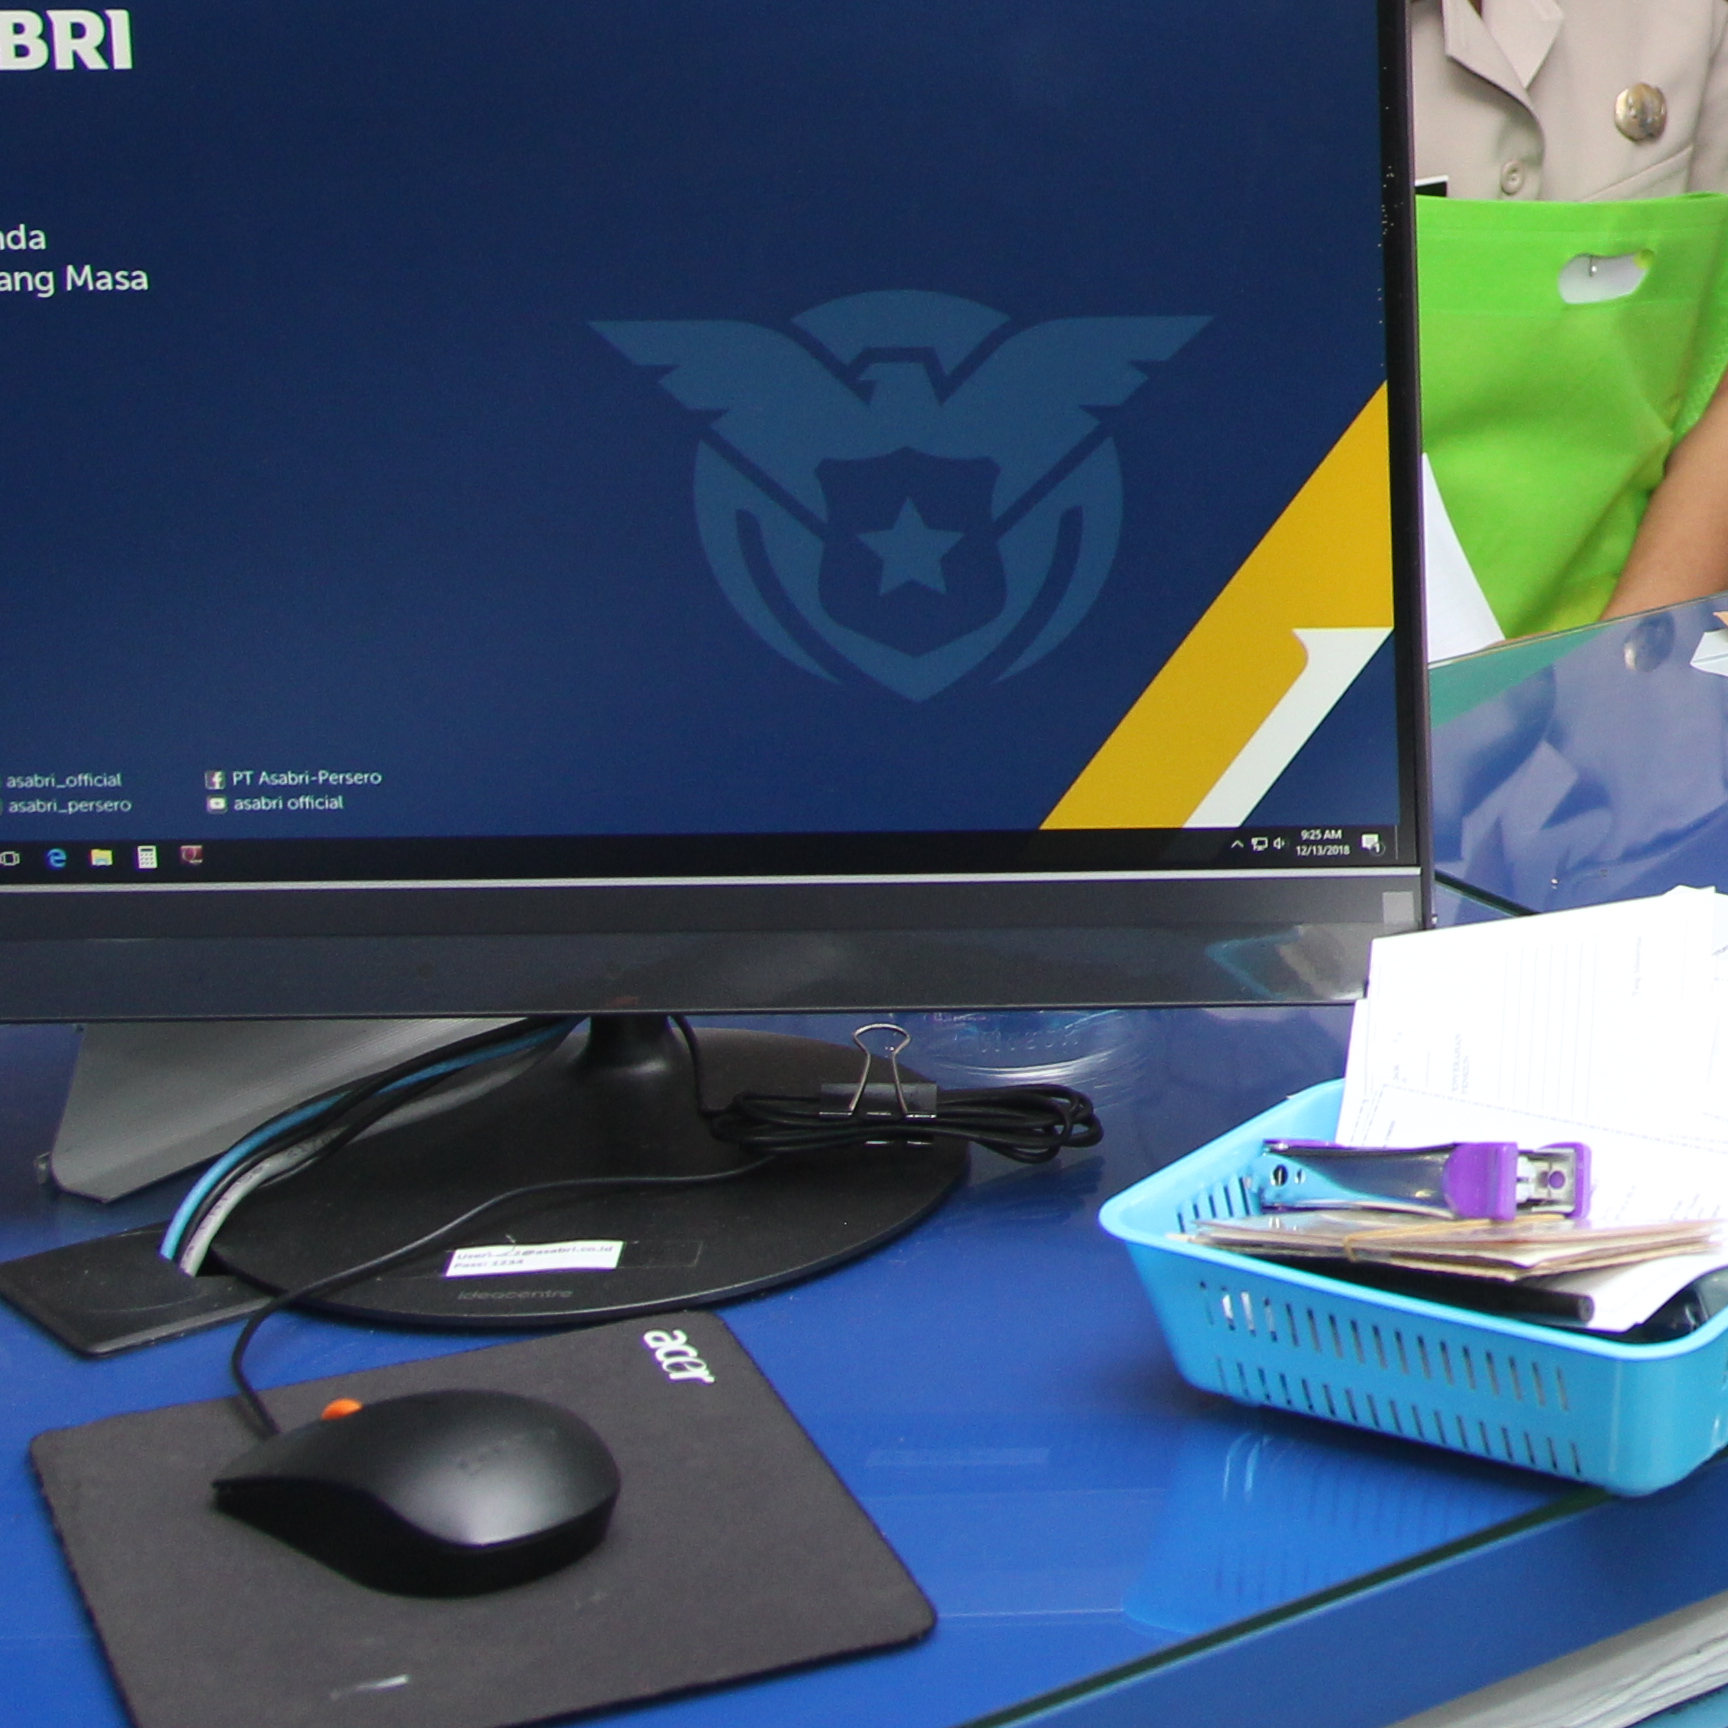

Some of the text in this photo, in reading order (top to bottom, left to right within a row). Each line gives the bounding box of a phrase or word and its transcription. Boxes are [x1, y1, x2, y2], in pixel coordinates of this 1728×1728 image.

[65, 263, 149, 292] Masa
[6, 772, 122, 789] asabri_official
[233, 769, 382, 787] PT Asabri-Persero
[8, 798, 132, 815] asabri_persero
[234, 794, 344, 812] asabri official
[1301, 829, 1342, 840] 9:25 AM
[1296, 845, 1350, 856] 12/13/2018
[643, 1328, 716, 1384] acer
